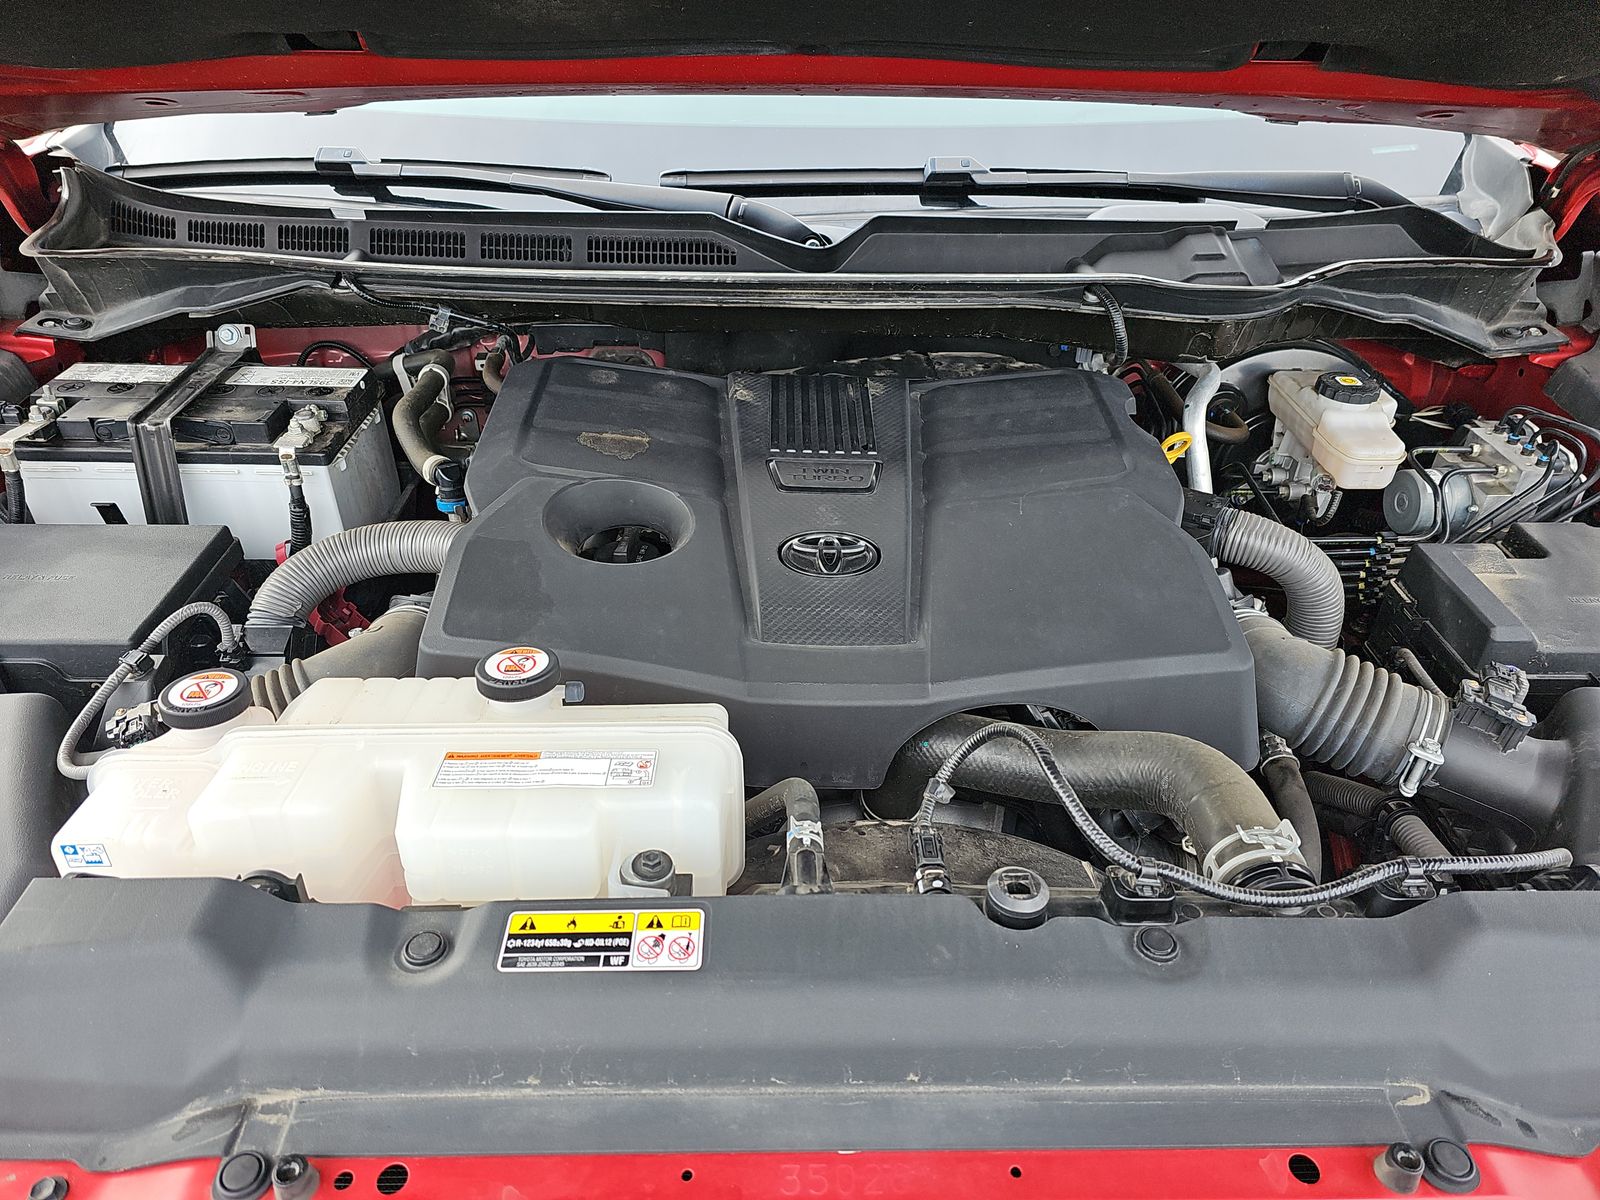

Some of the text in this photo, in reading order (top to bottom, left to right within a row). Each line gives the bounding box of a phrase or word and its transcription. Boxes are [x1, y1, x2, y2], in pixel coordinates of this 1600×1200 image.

[798, 467, 850, 475] TWIN
[789, 474, 865, 482] TURBO
[610, 956, 625, 966] WF
